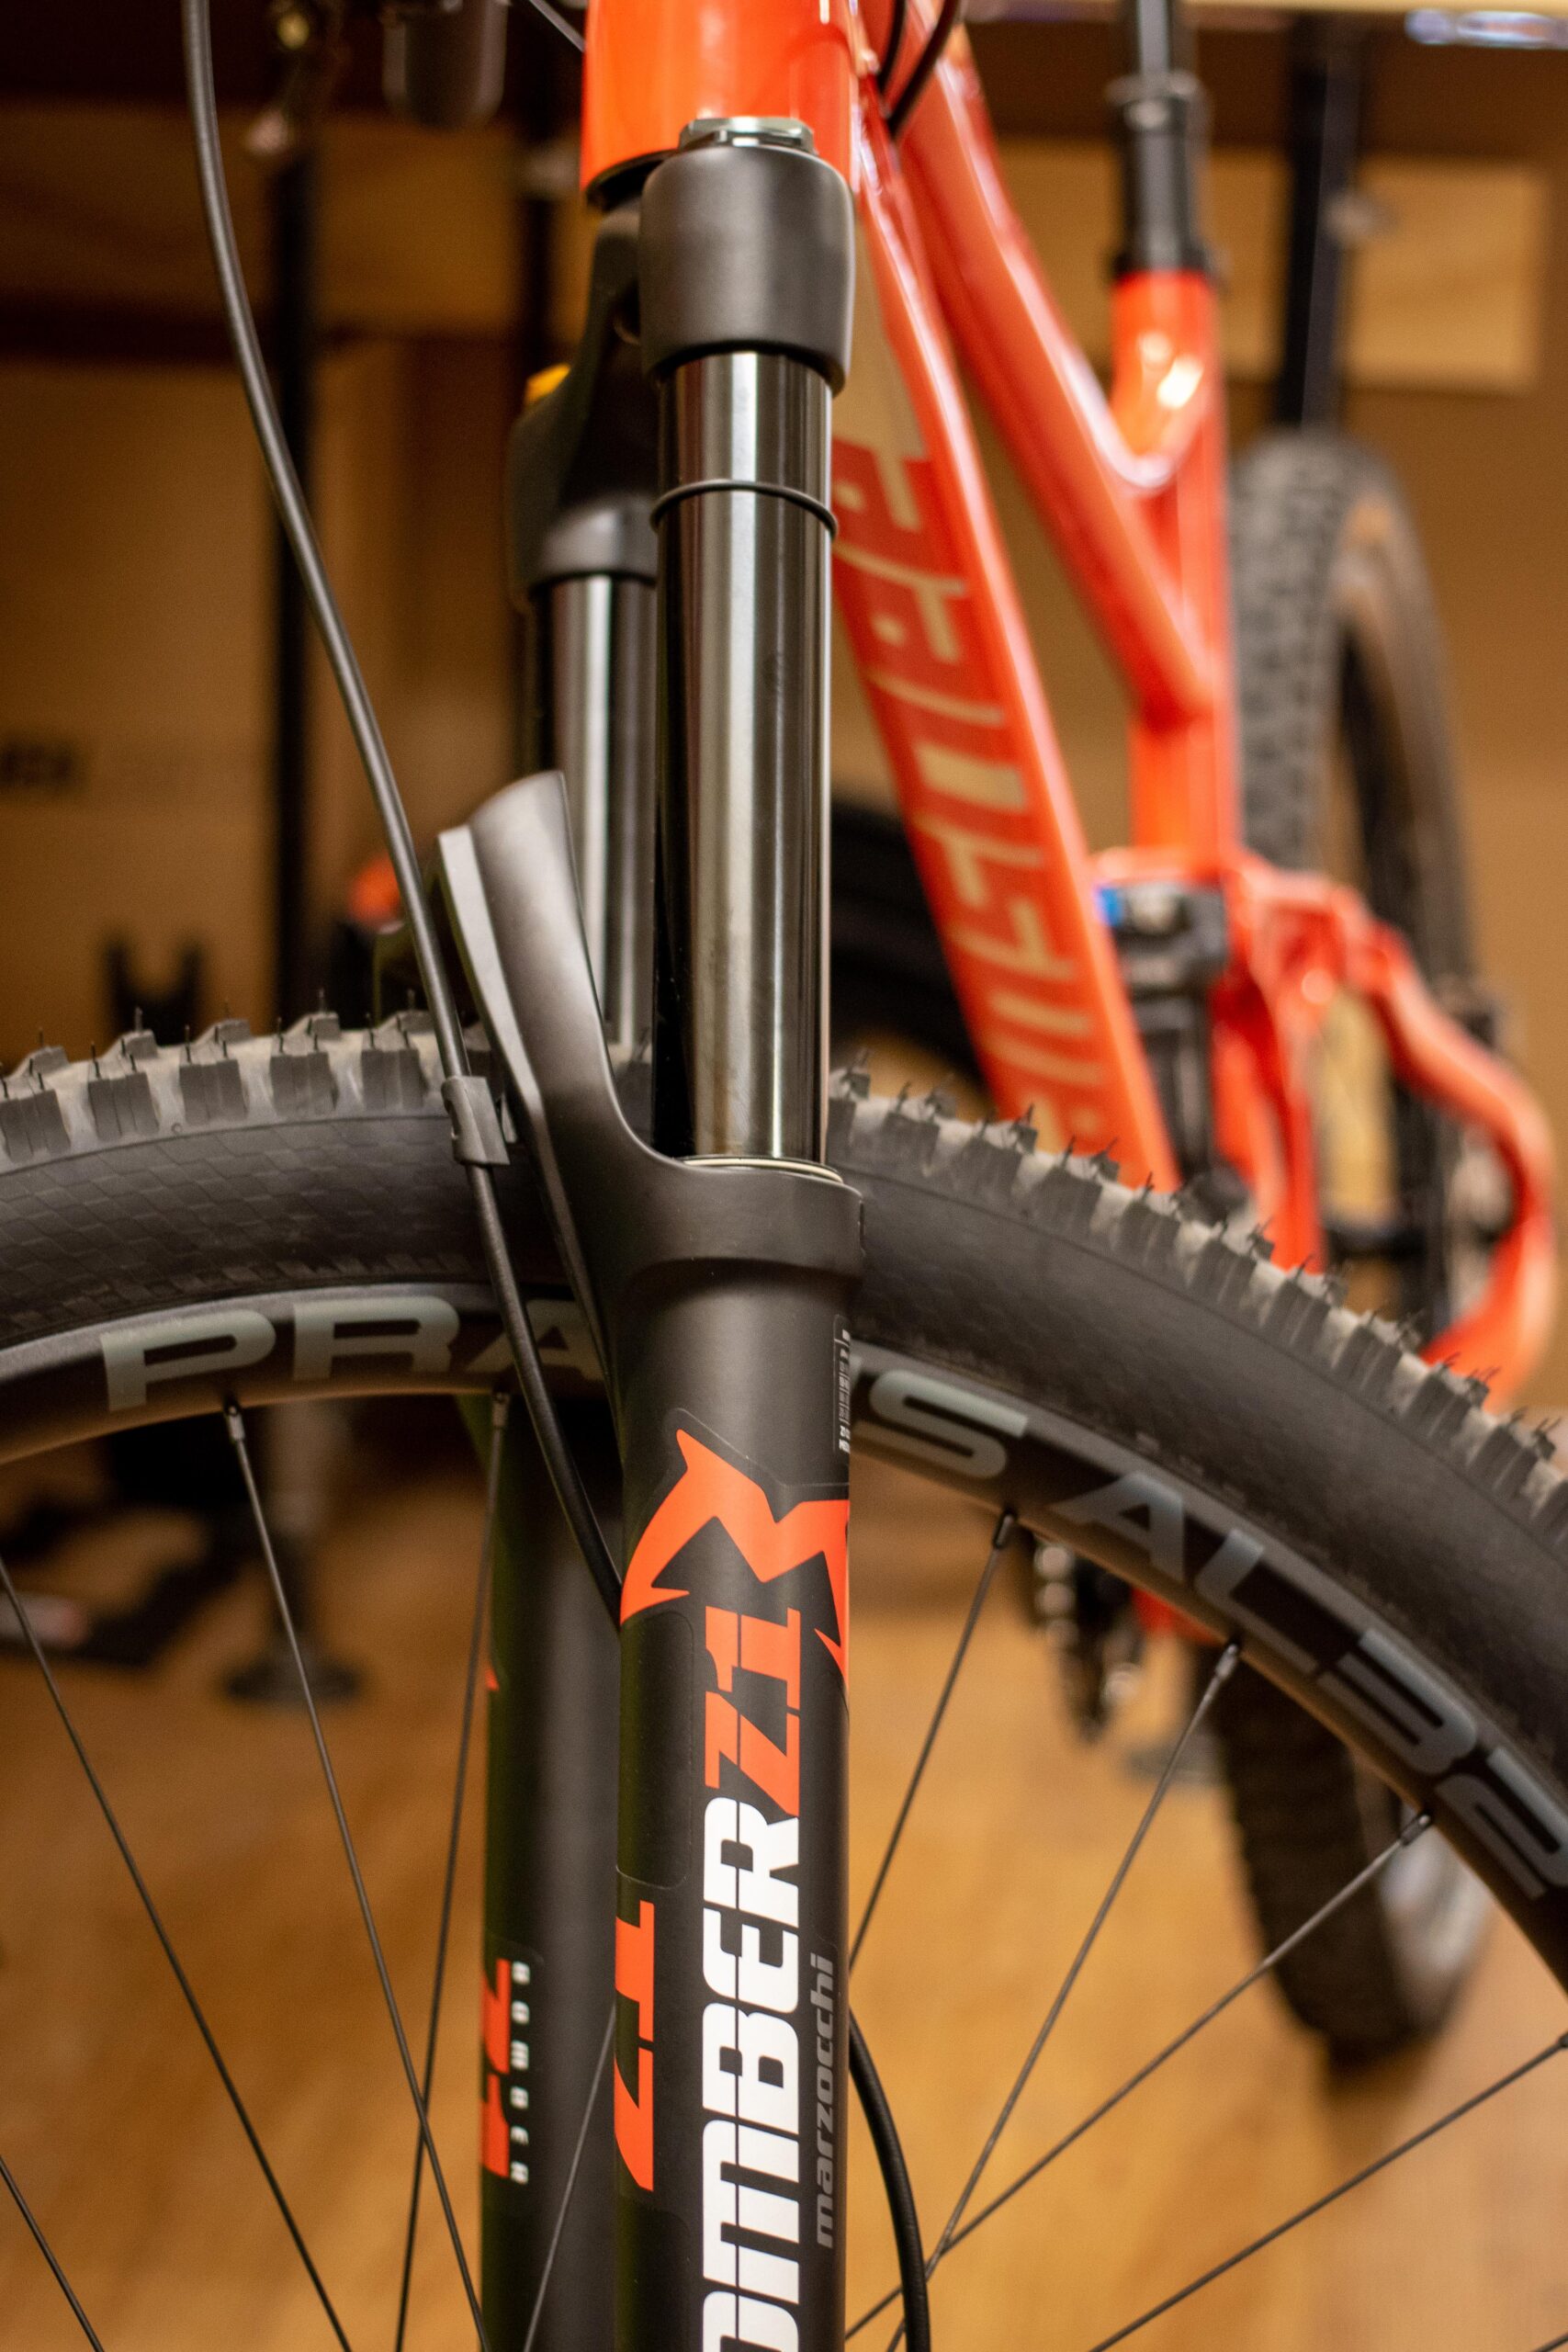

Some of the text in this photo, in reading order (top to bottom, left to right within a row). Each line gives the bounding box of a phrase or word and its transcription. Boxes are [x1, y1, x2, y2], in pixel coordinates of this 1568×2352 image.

[705, 1605, 801, 1818] Z1
[1045, 1472, 1568, 1901] AL32
[810, 1951, 835, 2249] marzocchi
